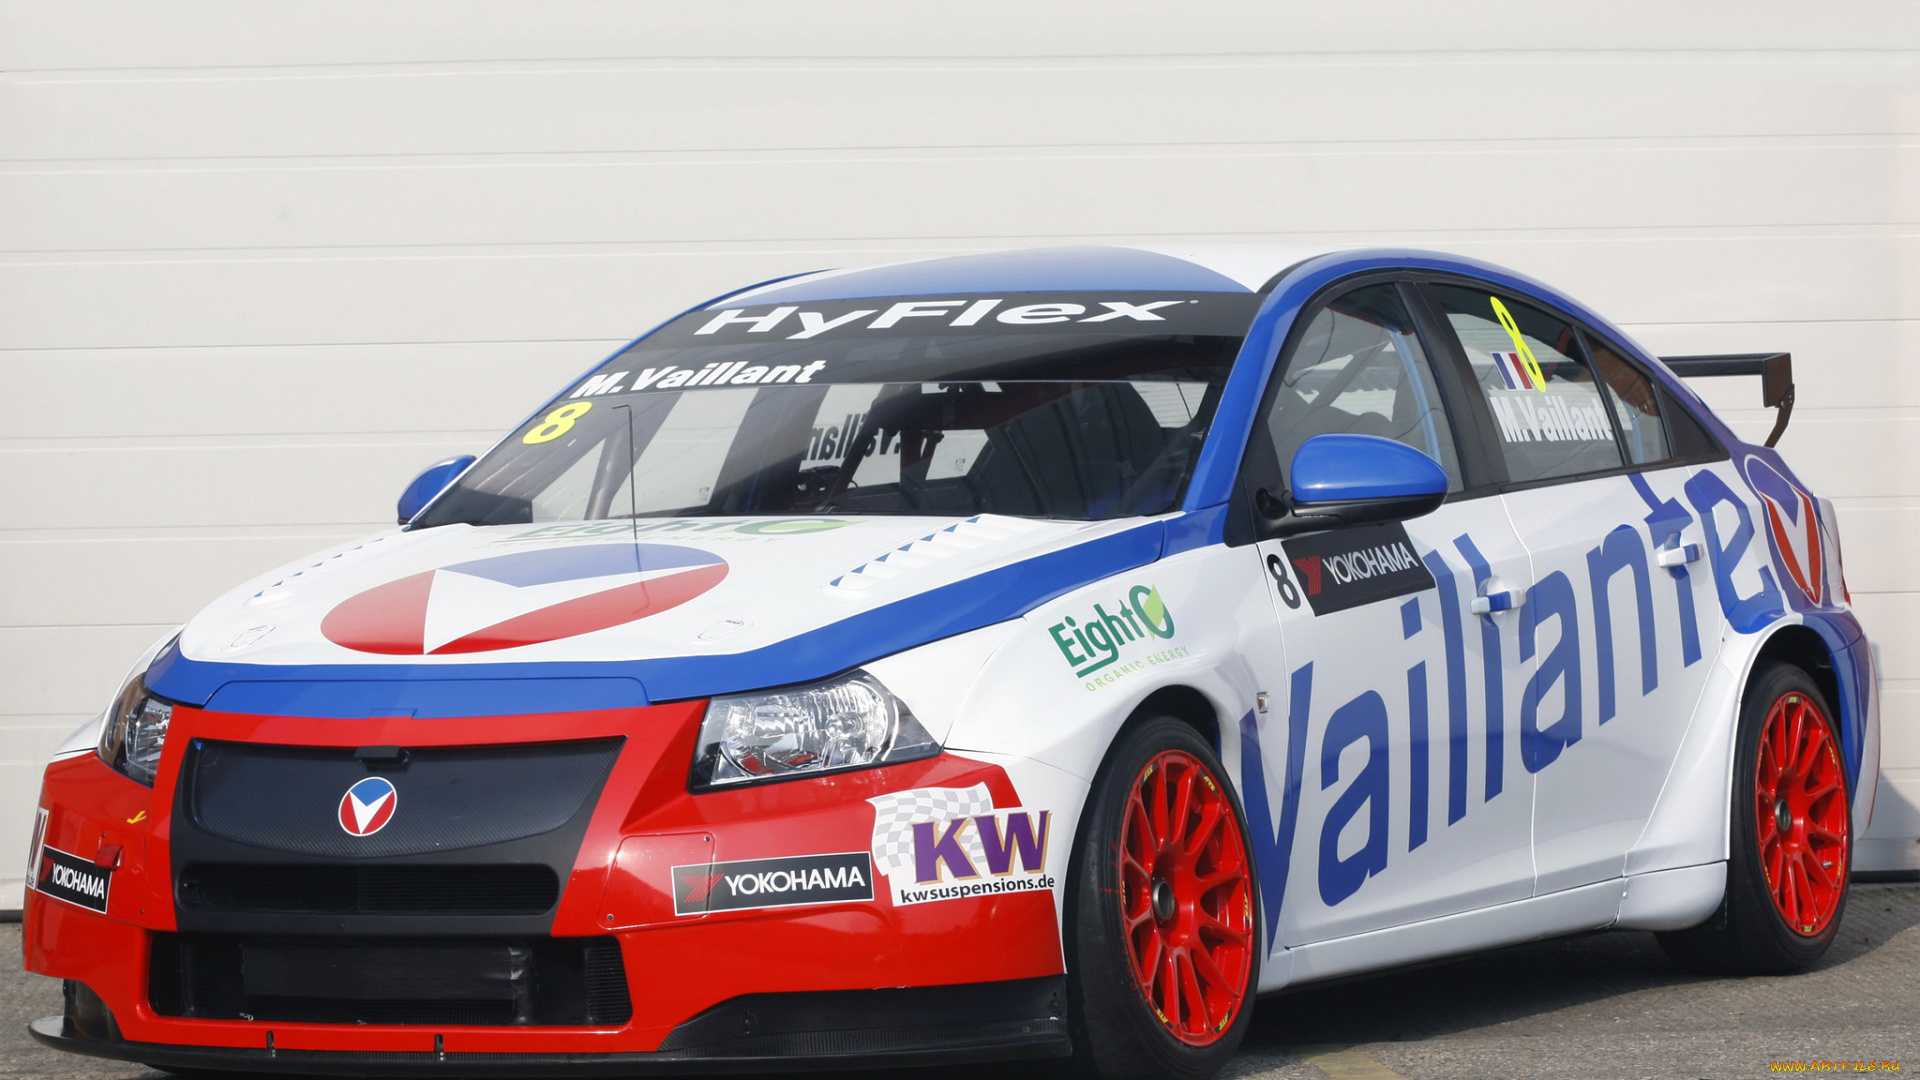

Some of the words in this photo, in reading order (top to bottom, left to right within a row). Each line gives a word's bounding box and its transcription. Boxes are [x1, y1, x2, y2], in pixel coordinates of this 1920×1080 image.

[694, 299, 1187, 339] HyFlex
[1490, 296, 1546, 393] 8
[522, 401, 593, 445] 8
[1267, 553, 1301, 609] 8
[1322, 542, 1419, 585] YOKOHAMA
[1085, 660, 1145, 692] ORGANIC
[1146, 646, 1190, 666] ENERGY
[1239, 469, 1787, 961] Vaillante
[911, 810, 1052, 885] KW
[52, 862, 105, 900] YOKOHAMA
[723, 865, 866, 897] YOKOHAMA
[900, 873, 1055, 904] kwsuspensions.de
